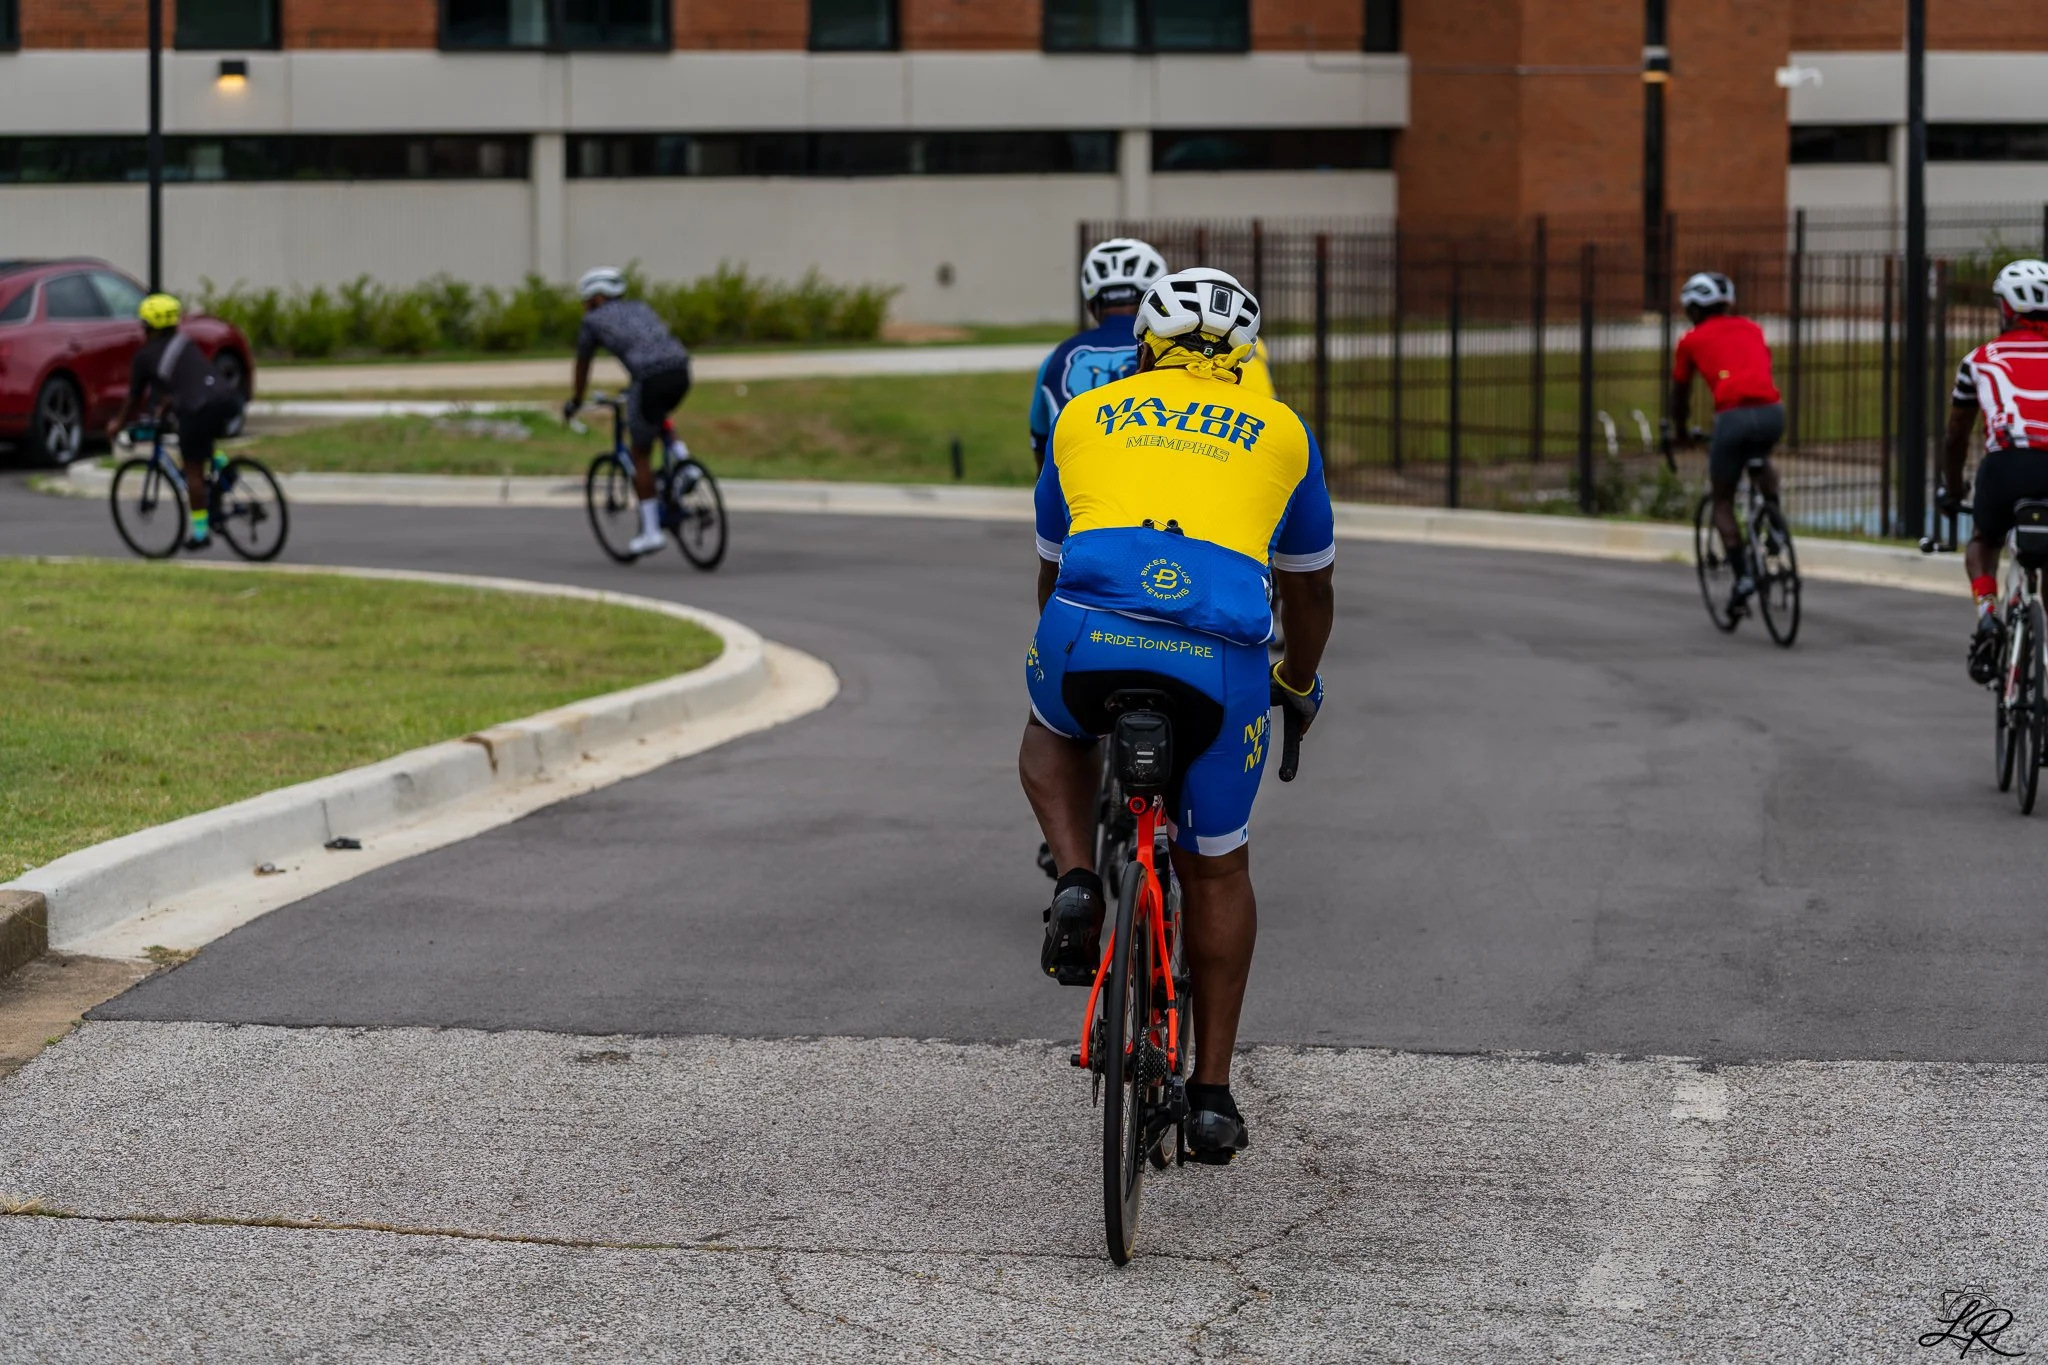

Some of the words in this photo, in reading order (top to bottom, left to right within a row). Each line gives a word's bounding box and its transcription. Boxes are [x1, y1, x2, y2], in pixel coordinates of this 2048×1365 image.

[1095, 396, 1266, 437] MAJOR
[1100, 411, 1259, 452] TAYLOR
[1125, 434, 1230, 463] MEMPHIS
[1140, 559, 1167, 577] BIKES
[1170, 561, 1192, 585] PLUS
[1141, 581, 1190, 601] MEMPHIS
